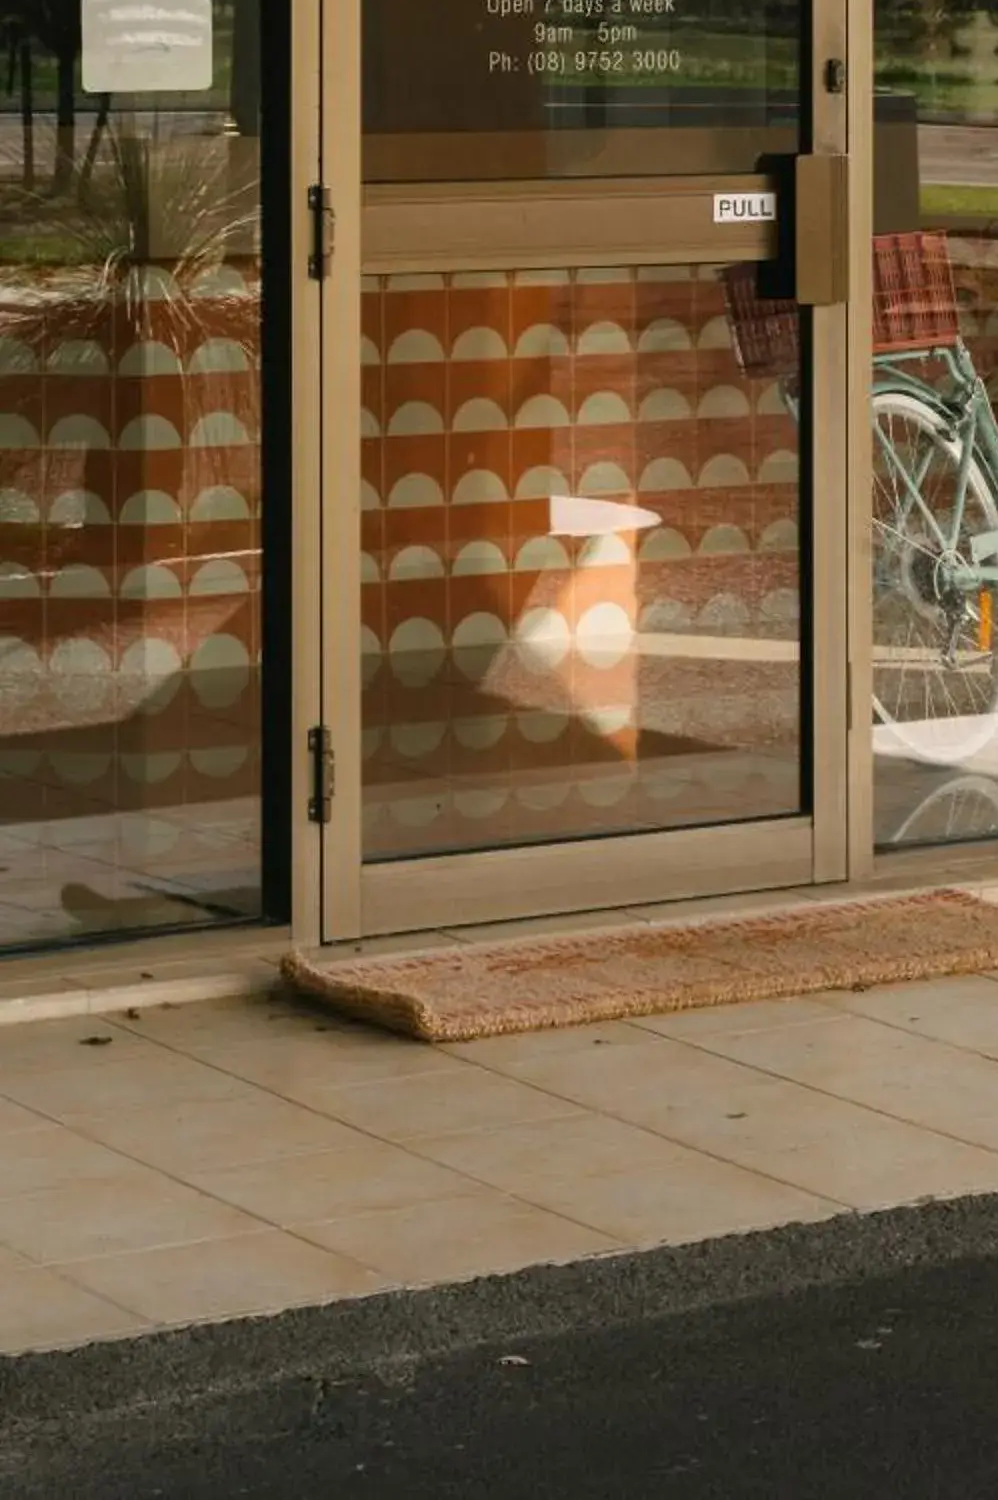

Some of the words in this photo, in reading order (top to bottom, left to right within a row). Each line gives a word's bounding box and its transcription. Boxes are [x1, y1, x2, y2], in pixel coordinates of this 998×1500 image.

[535, 22, 573, 42] 9am
[599, 22, 637, 44] 5pm
[489, 52, 519, 72] Ph:
[528, 51, 565, 75] (08)
[575, 51, 623, 71] 9752
[632, 50, 680, 71] 3000
[719, 199, 772, 217] PULL
